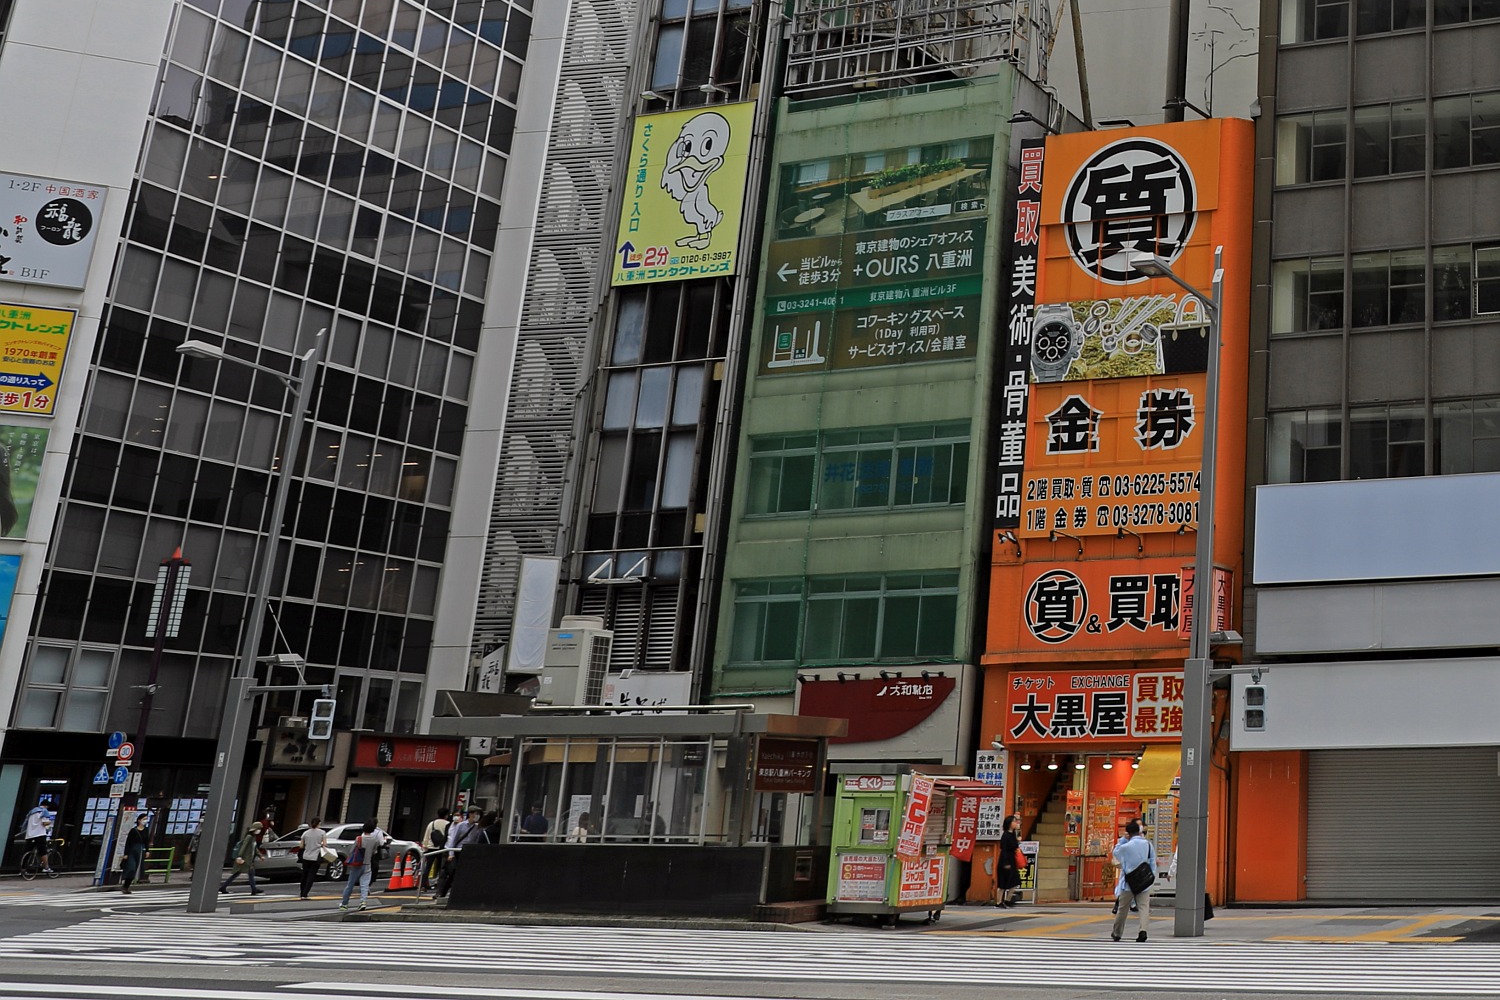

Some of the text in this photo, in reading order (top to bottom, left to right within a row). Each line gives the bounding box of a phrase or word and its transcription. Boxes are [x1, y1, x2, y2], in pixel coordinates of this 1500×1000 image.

[628, 123, 654, 233] さくら通り入口
[1081, 154, 1181, 268] 質
[40, 225, 62, 233] フーロン
[854, 229, 974, 255] 東京建物のシェアオフィス
[644, 246, 670, 267] 2分
[680, 251, 732, 264] 0120-61-3987
[800, 254, 843, 271] 当ビルから
[925, 248, 974, 271] 八重洲
[20, 267, 50, 280] B1F
[799, 269, 842, 286] 徒歩3分
[869, 283, 958, 303] 東京建物八重洲ビル3F
[856, 305, 966, 329] コワーキングスペース
[4, 347, 58, 360] 1970年創業
[848, 334, 967, 360] サービスオフィス/会議室
[1026, 478, 1048, 502] 2階
[1113, 470, 1201, 498] 03-6225-5574
[1026, 501, 1200, 531] 1階 金券 03-3278-3081
[1030, 576, 1082, 636] 質
[1085, 614, 1103, 635] &
[1013, 674, 1130, 690] チケット EXCHANGE
[1011, 691, 1128, 739] 大黒屋
[859, 777, 882, 789] 宝くじ
